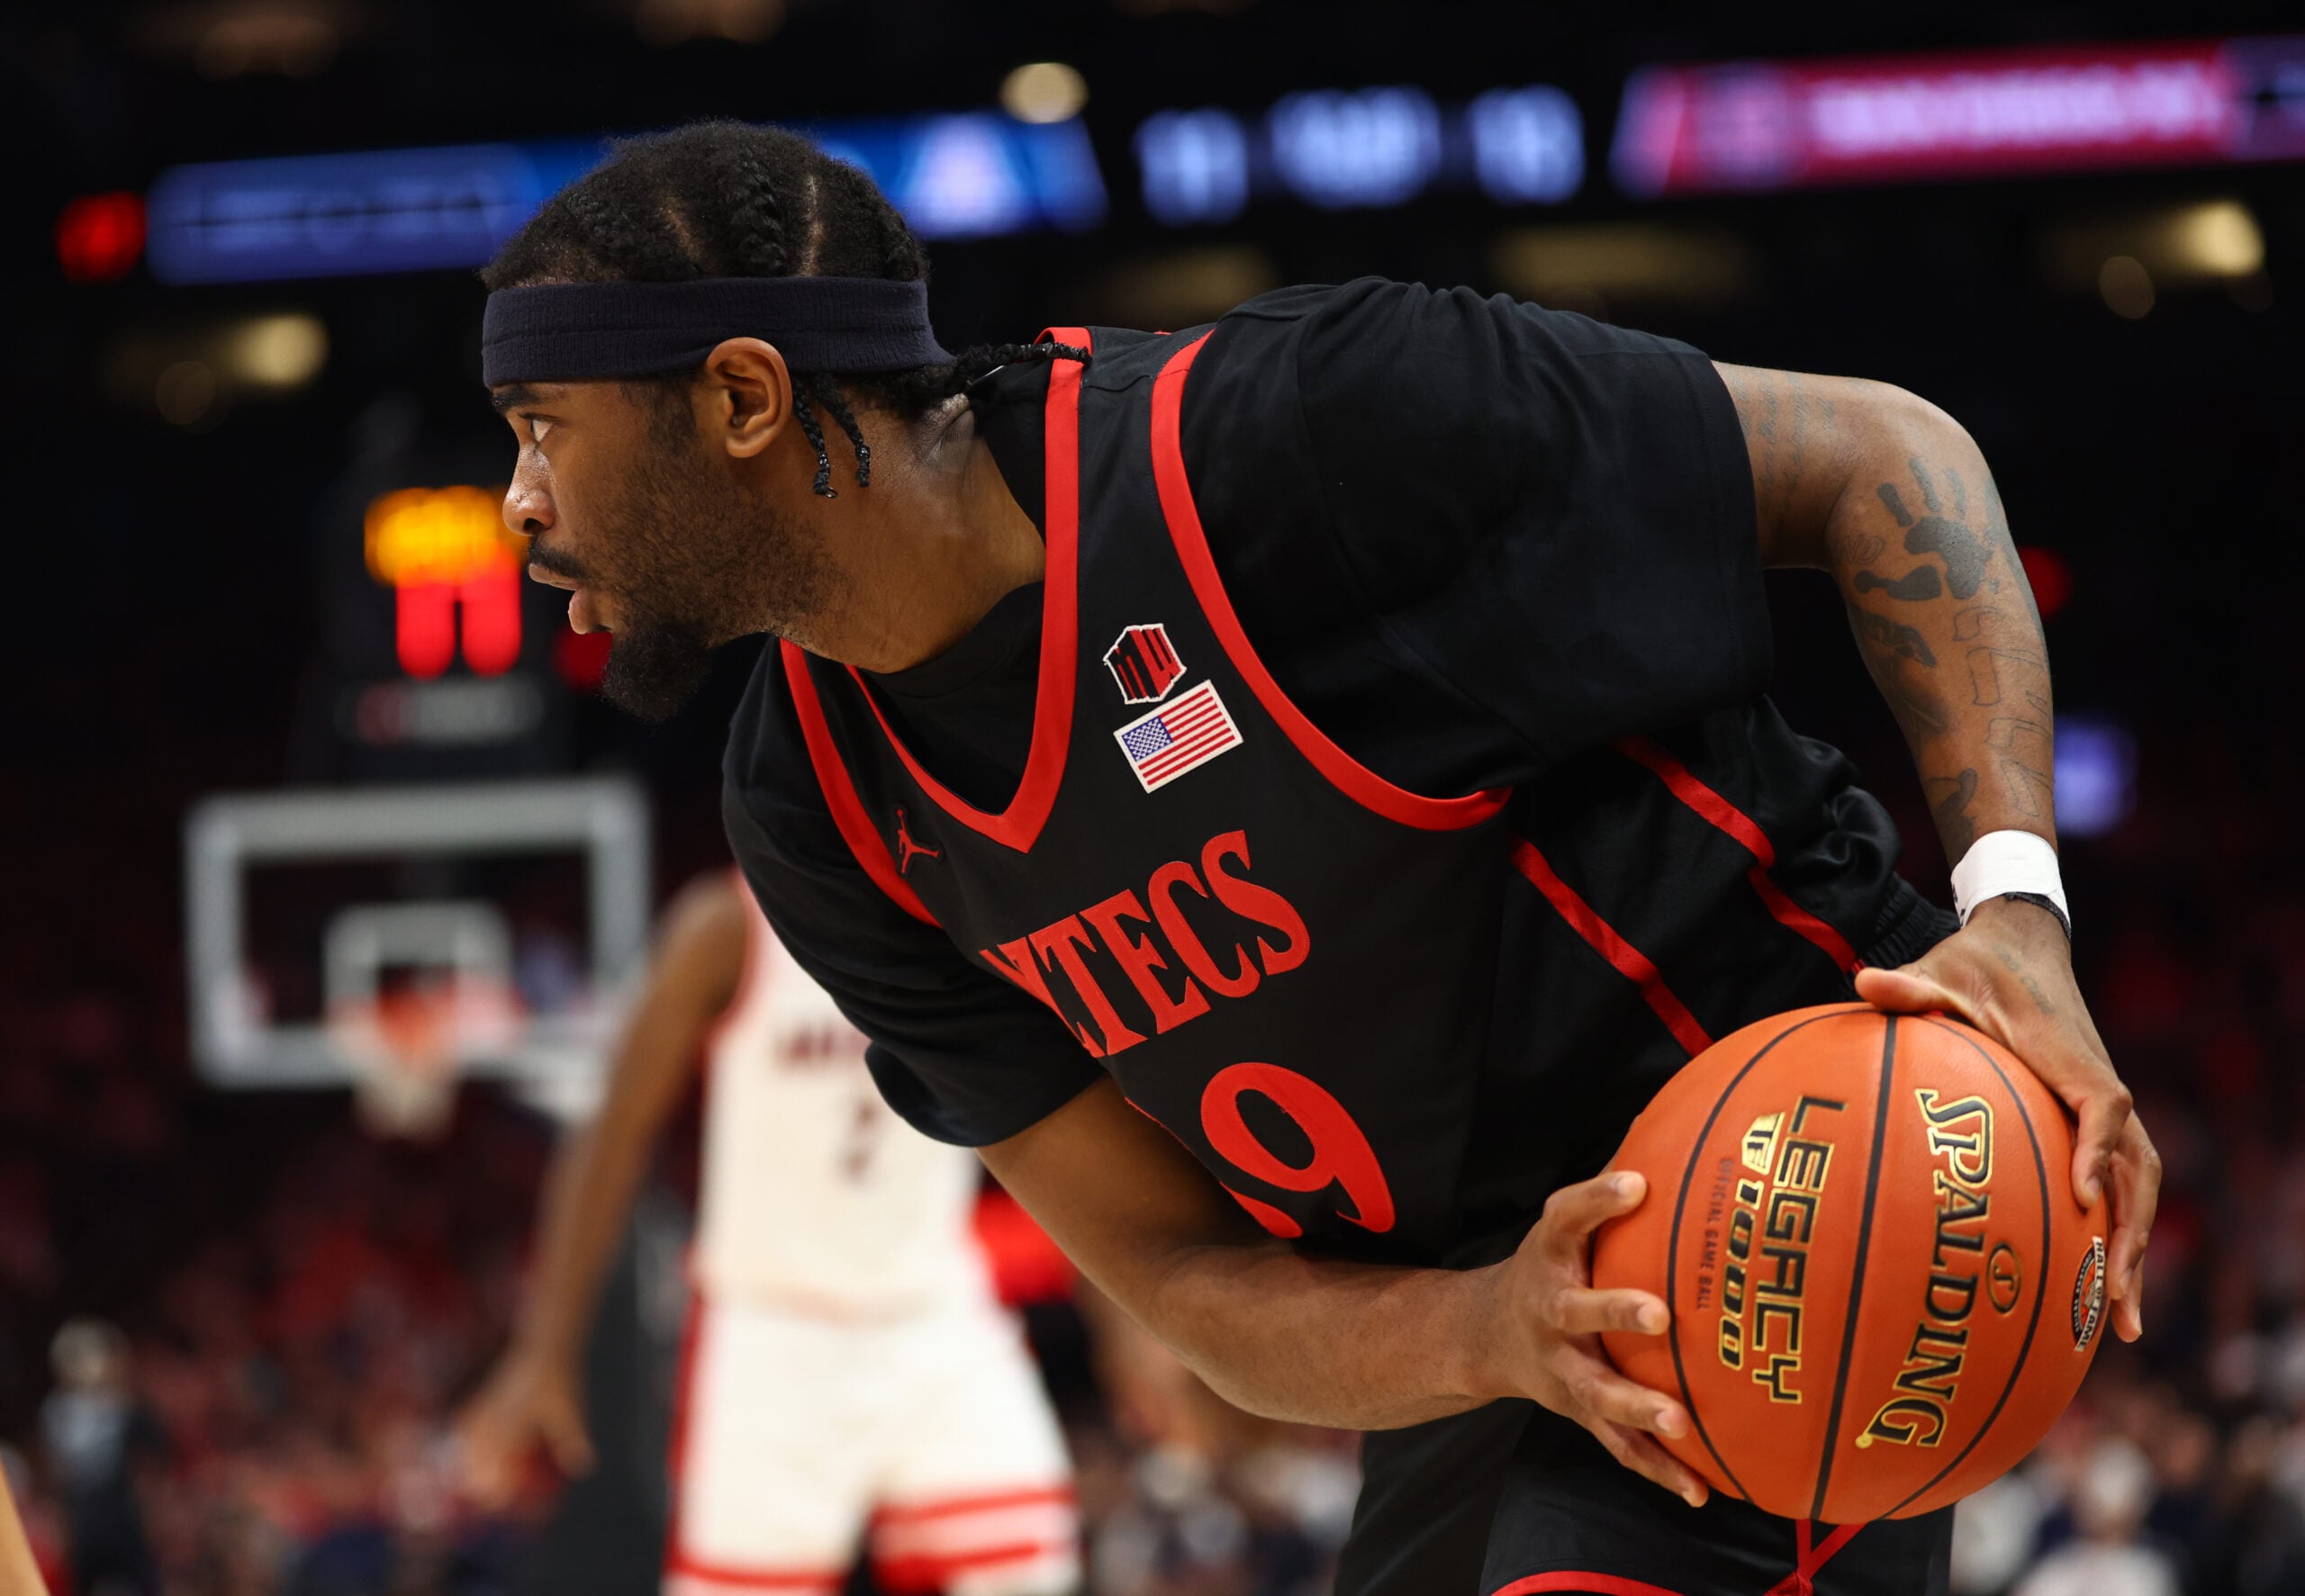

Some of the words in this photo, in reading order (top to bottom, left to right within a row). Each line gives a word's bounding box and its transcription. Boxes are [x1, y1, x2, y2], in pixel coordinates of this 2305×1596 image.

[979, 829, 1310, 1058] ZTECS
[1125, 1061, 1395, 1238] 9
[1707, 1157, 1734, 1222] OFFICIAL
[1696, 1276, 1713, 1310] BALL
[1700, 1229, 1718, 1269] GAME
[1718, 1177, 1764, 1370] 1000
[1752, 1096, 1847, 1404] LEGACY
[1856, 1088, 1994, 1448] SPALDING
[2077, 1306, 2098, 1348] FAME
